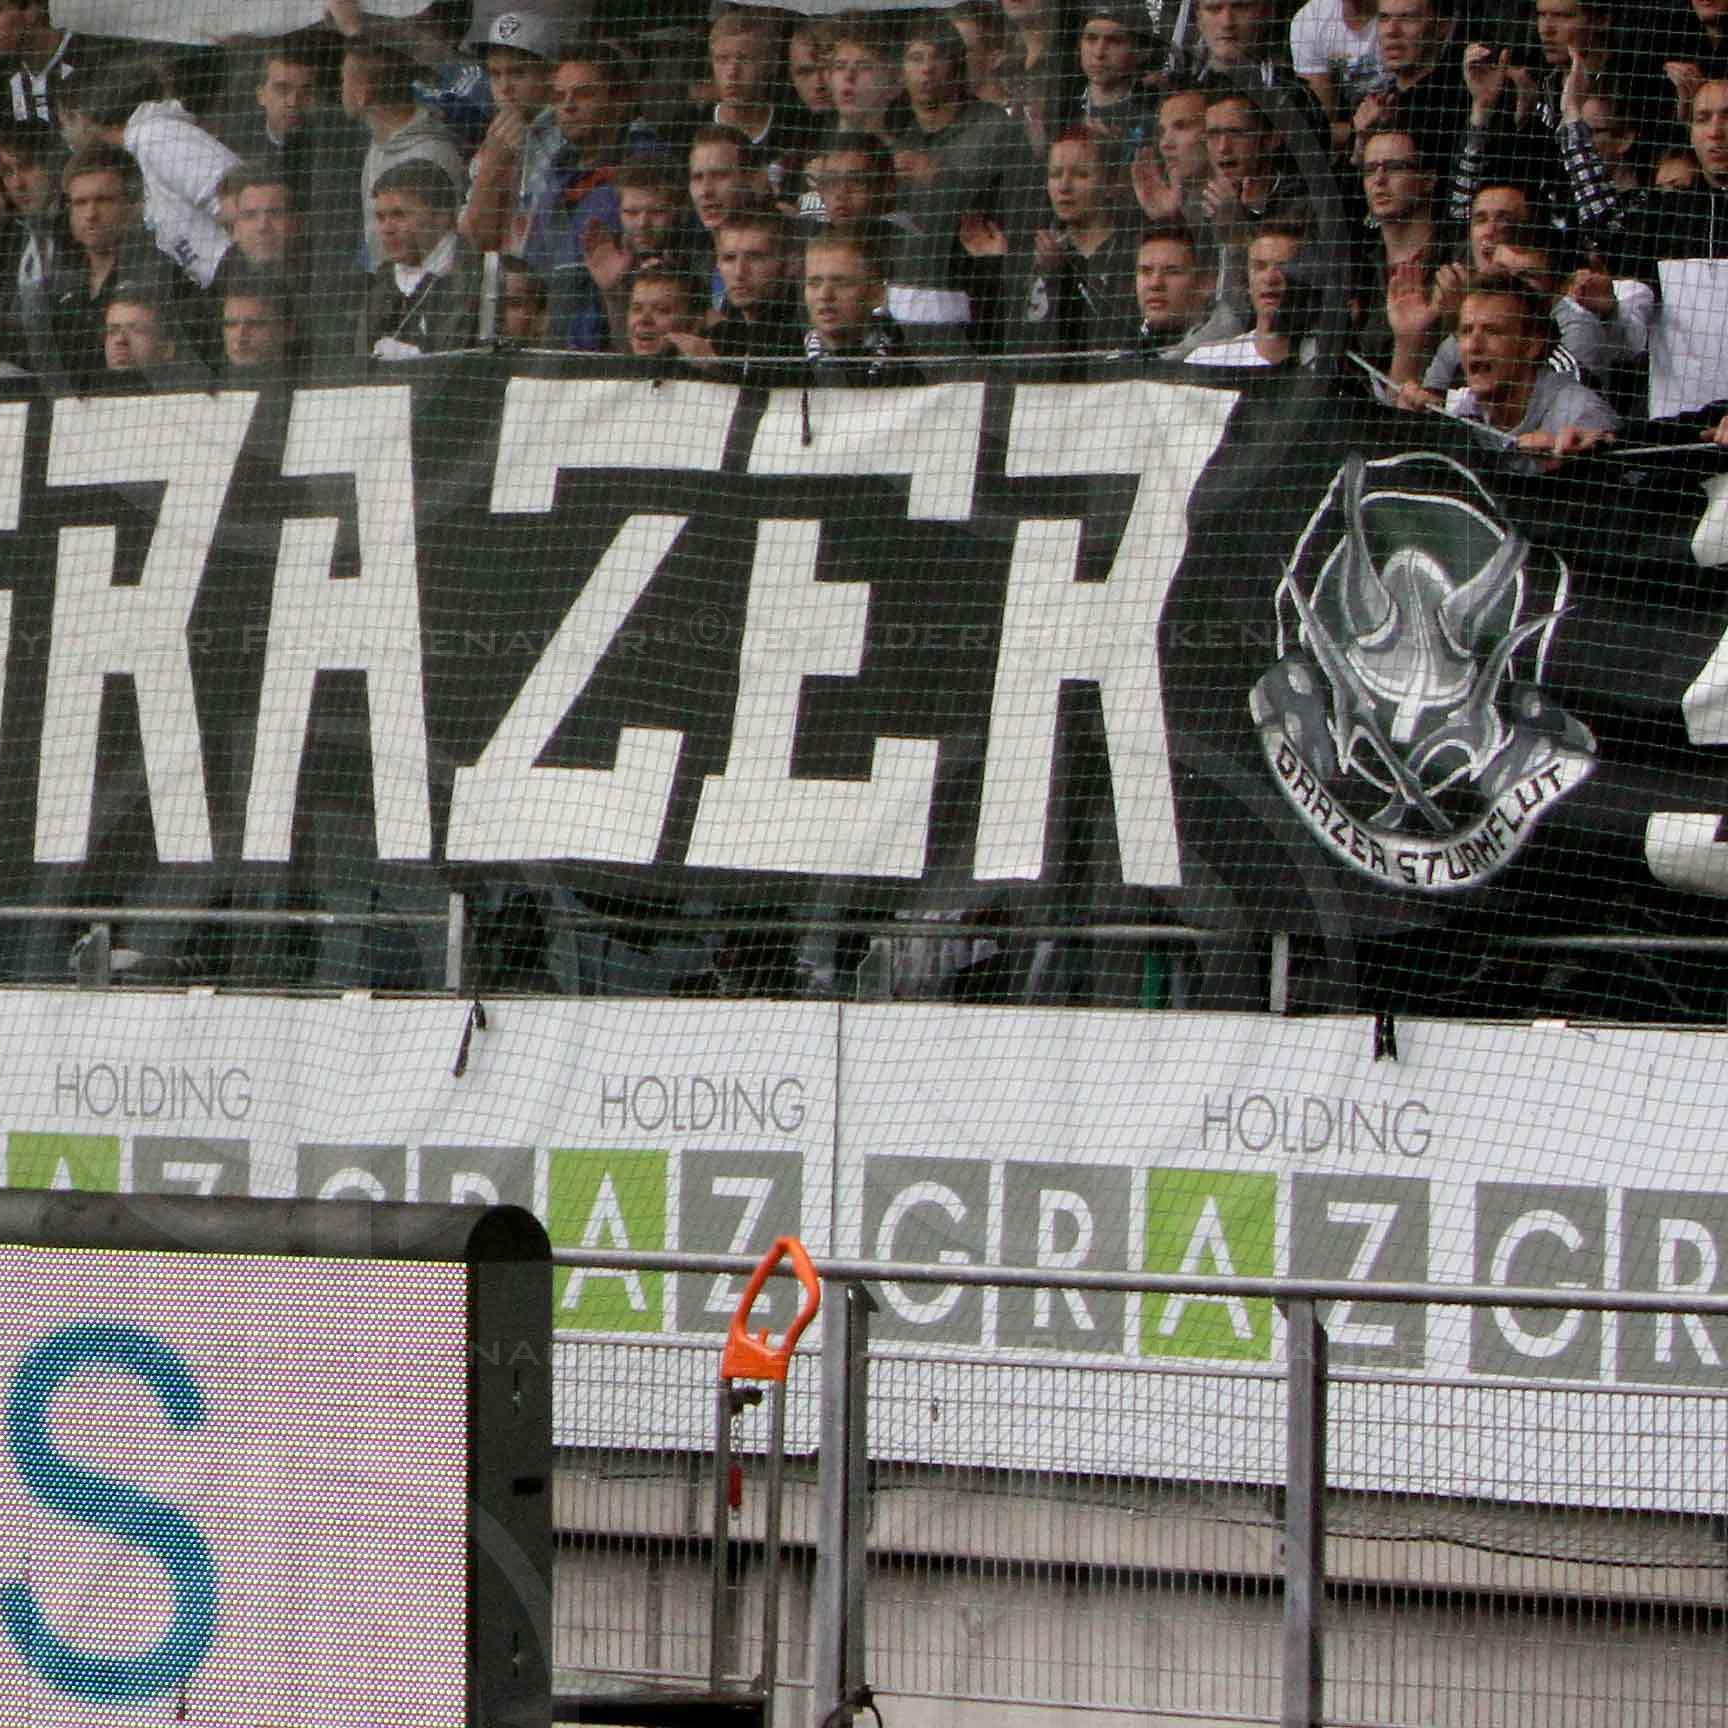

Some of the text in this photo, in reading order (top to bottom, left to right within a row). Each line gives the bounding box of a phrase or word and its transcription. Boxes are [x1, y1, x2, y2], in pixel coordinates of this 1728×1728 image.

[1275, 741, 1566, 887] GRAZER STURMFLUT
[55, 1062, 253, 1120] HOLDING
[600, 1074, 807, 1133] HOLDING
[1200, 1093, 1433, 1158] HOLDING
[875, 1180, 1400, 1347] GRAZ
